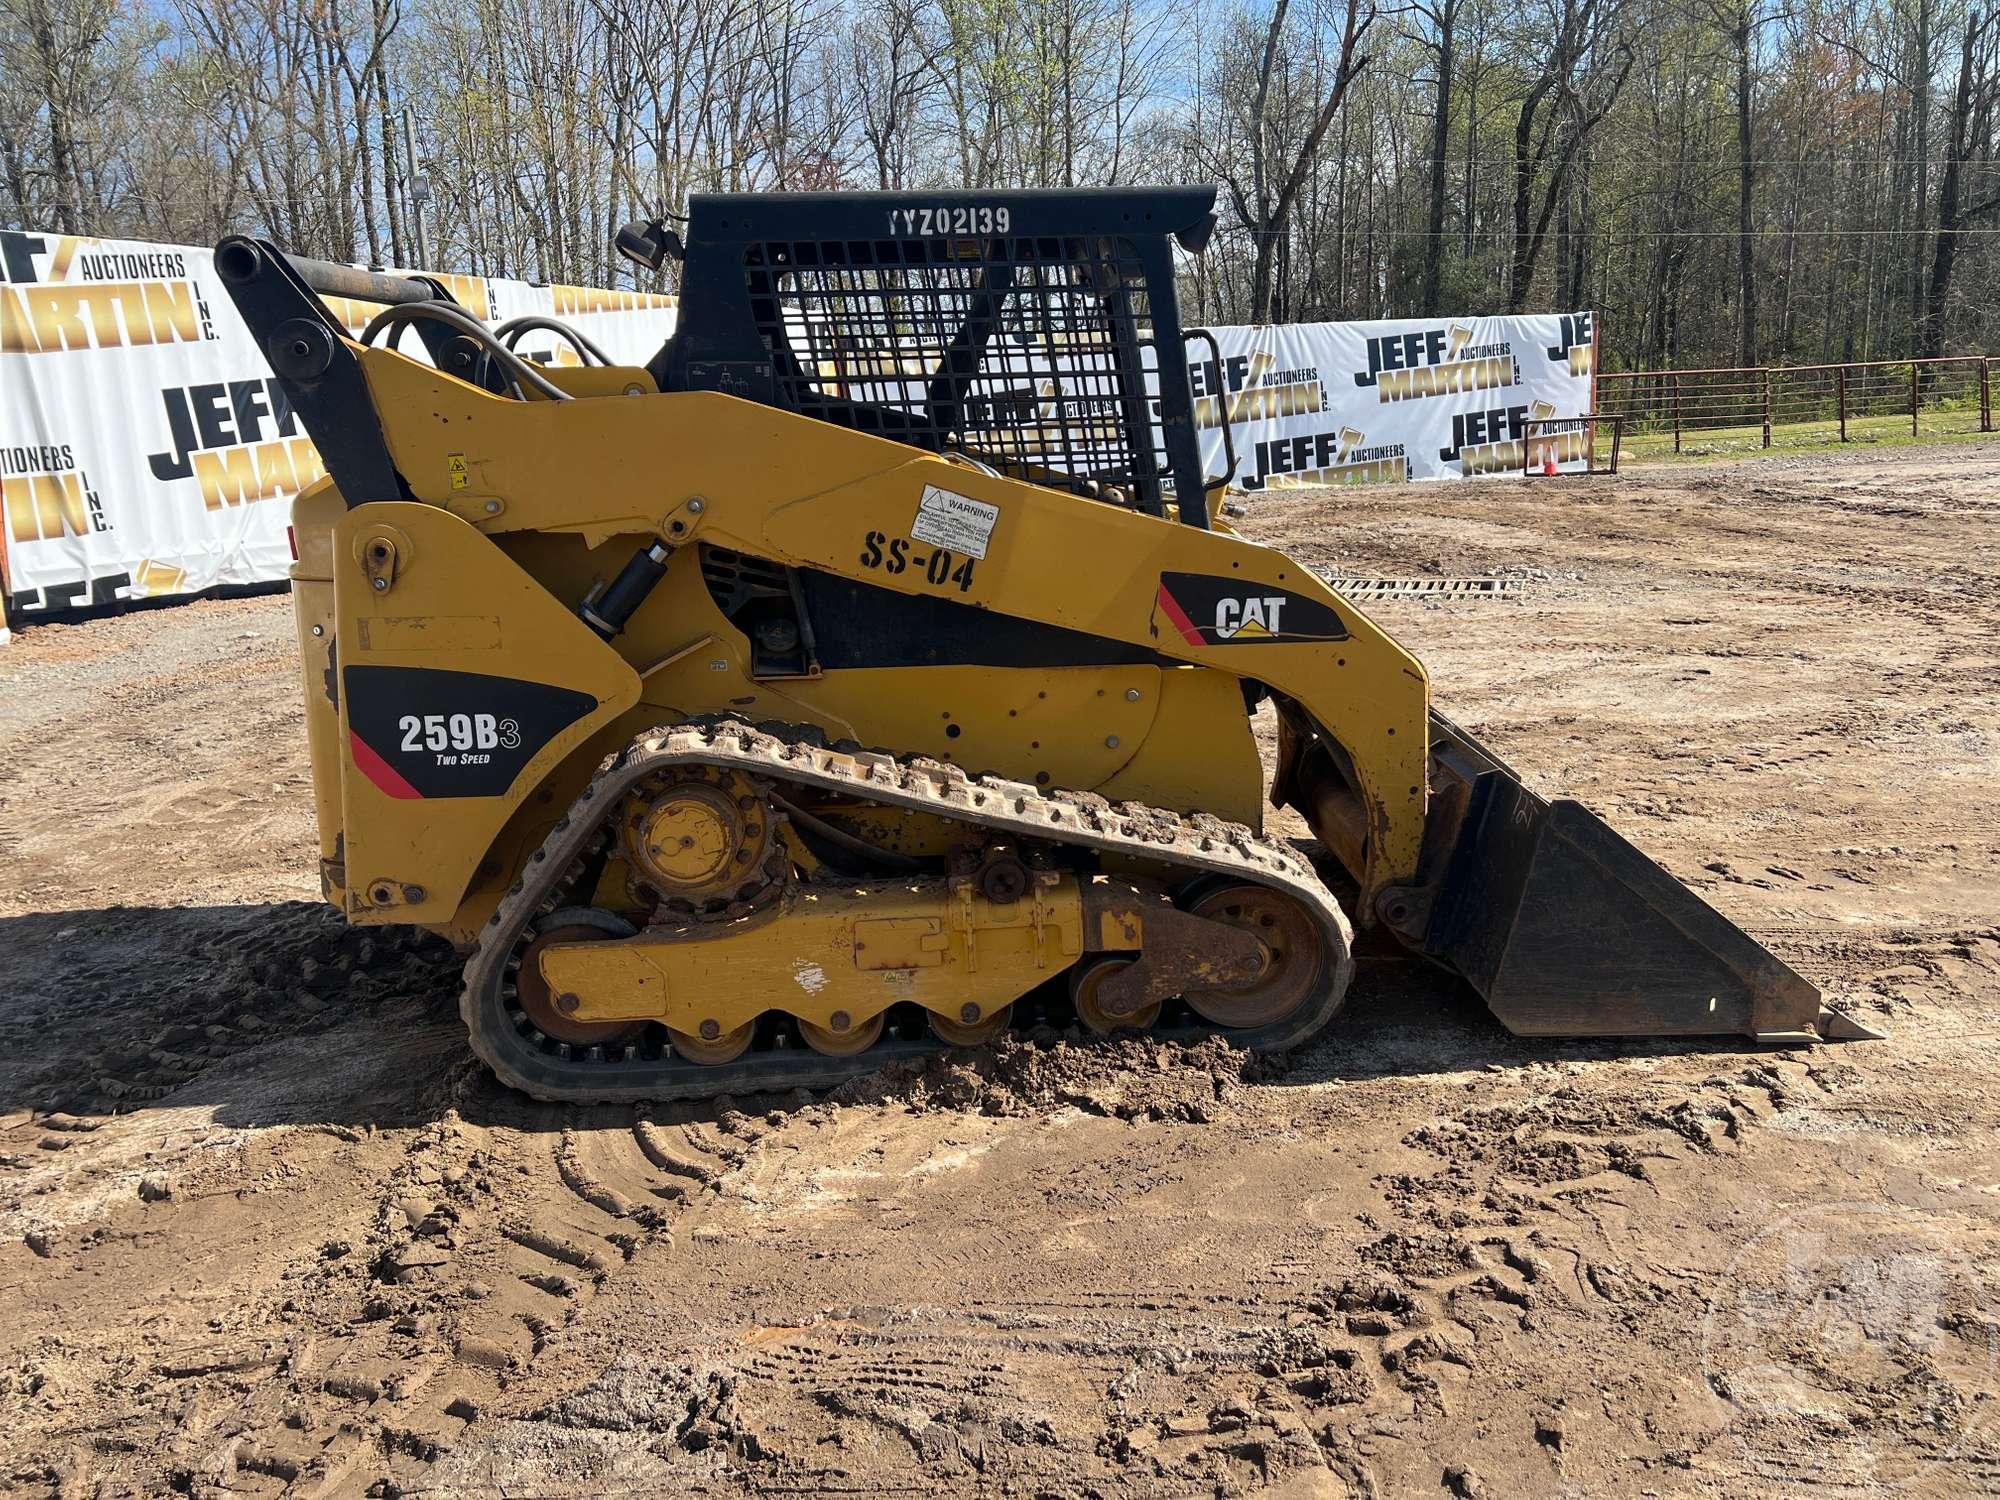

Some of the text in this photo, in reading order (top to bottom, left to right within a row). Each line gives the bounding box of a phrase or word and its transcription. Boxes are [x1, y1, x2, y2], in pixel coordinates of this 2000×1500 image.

[81, 253, 186, 281] AUCTIONEERS
[0, 281, 200, 354] ARTIN
[1354, 330, 1447, 387] JEFF
[1460, 342, 1511, 361] AUCTIONEERS
[1189, 355, 1249, 398] EFF
[1262, 367, 1318, 386] AUCTIONEERS
[1378, 356, 1512, 404] MARTIN
[1350, 443, 1405, 464] AUCTIONEERS
[1440, 405, 1529, 462] JEFF
[1241, 432, 1337, 490] JEFF
[949, 499, 995, 521] WARNING
[860, 531, 975, 592] SS-04
[1215, 597, 1287, 640] CAT
